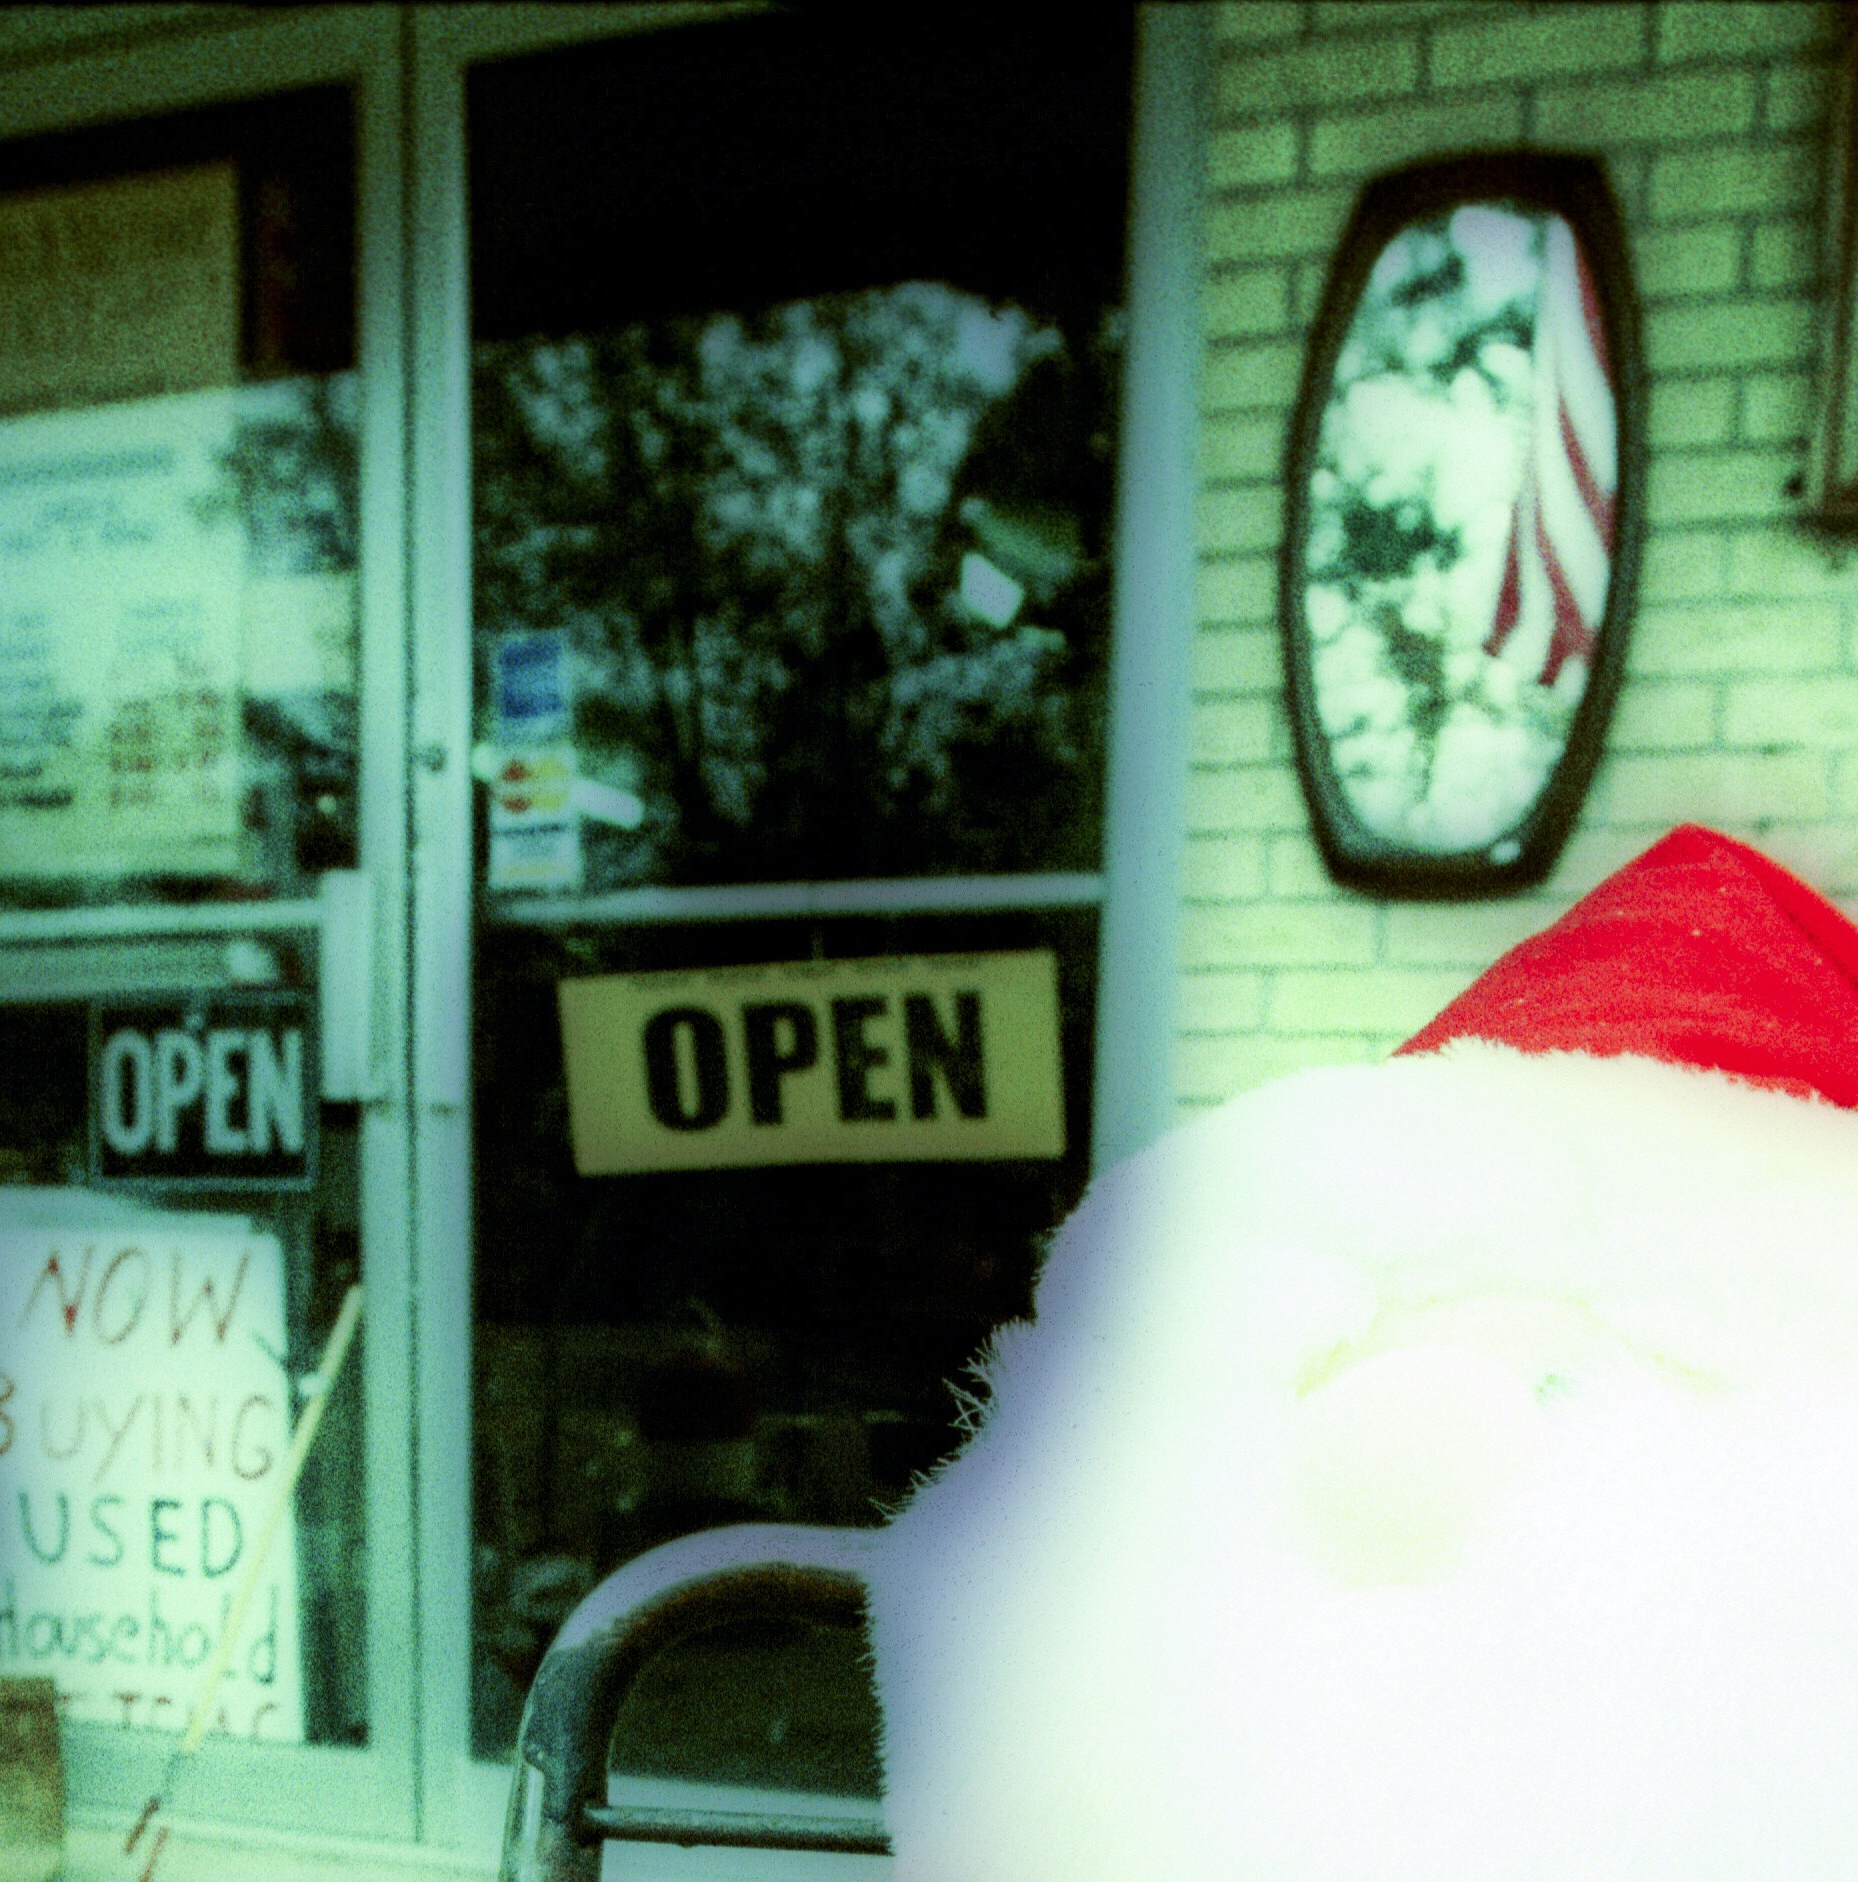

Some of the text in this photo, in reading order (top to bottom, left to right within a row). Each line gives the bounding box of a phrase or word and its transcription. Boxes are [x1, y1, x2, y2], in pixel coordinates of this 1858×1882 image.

[102, 1026, 305, 1156] OPEN
[641, 990, 988, 1133] OPEN
[15, 1244, 252, 1346] NOW
[16, 1490, 244, 1579] USED
